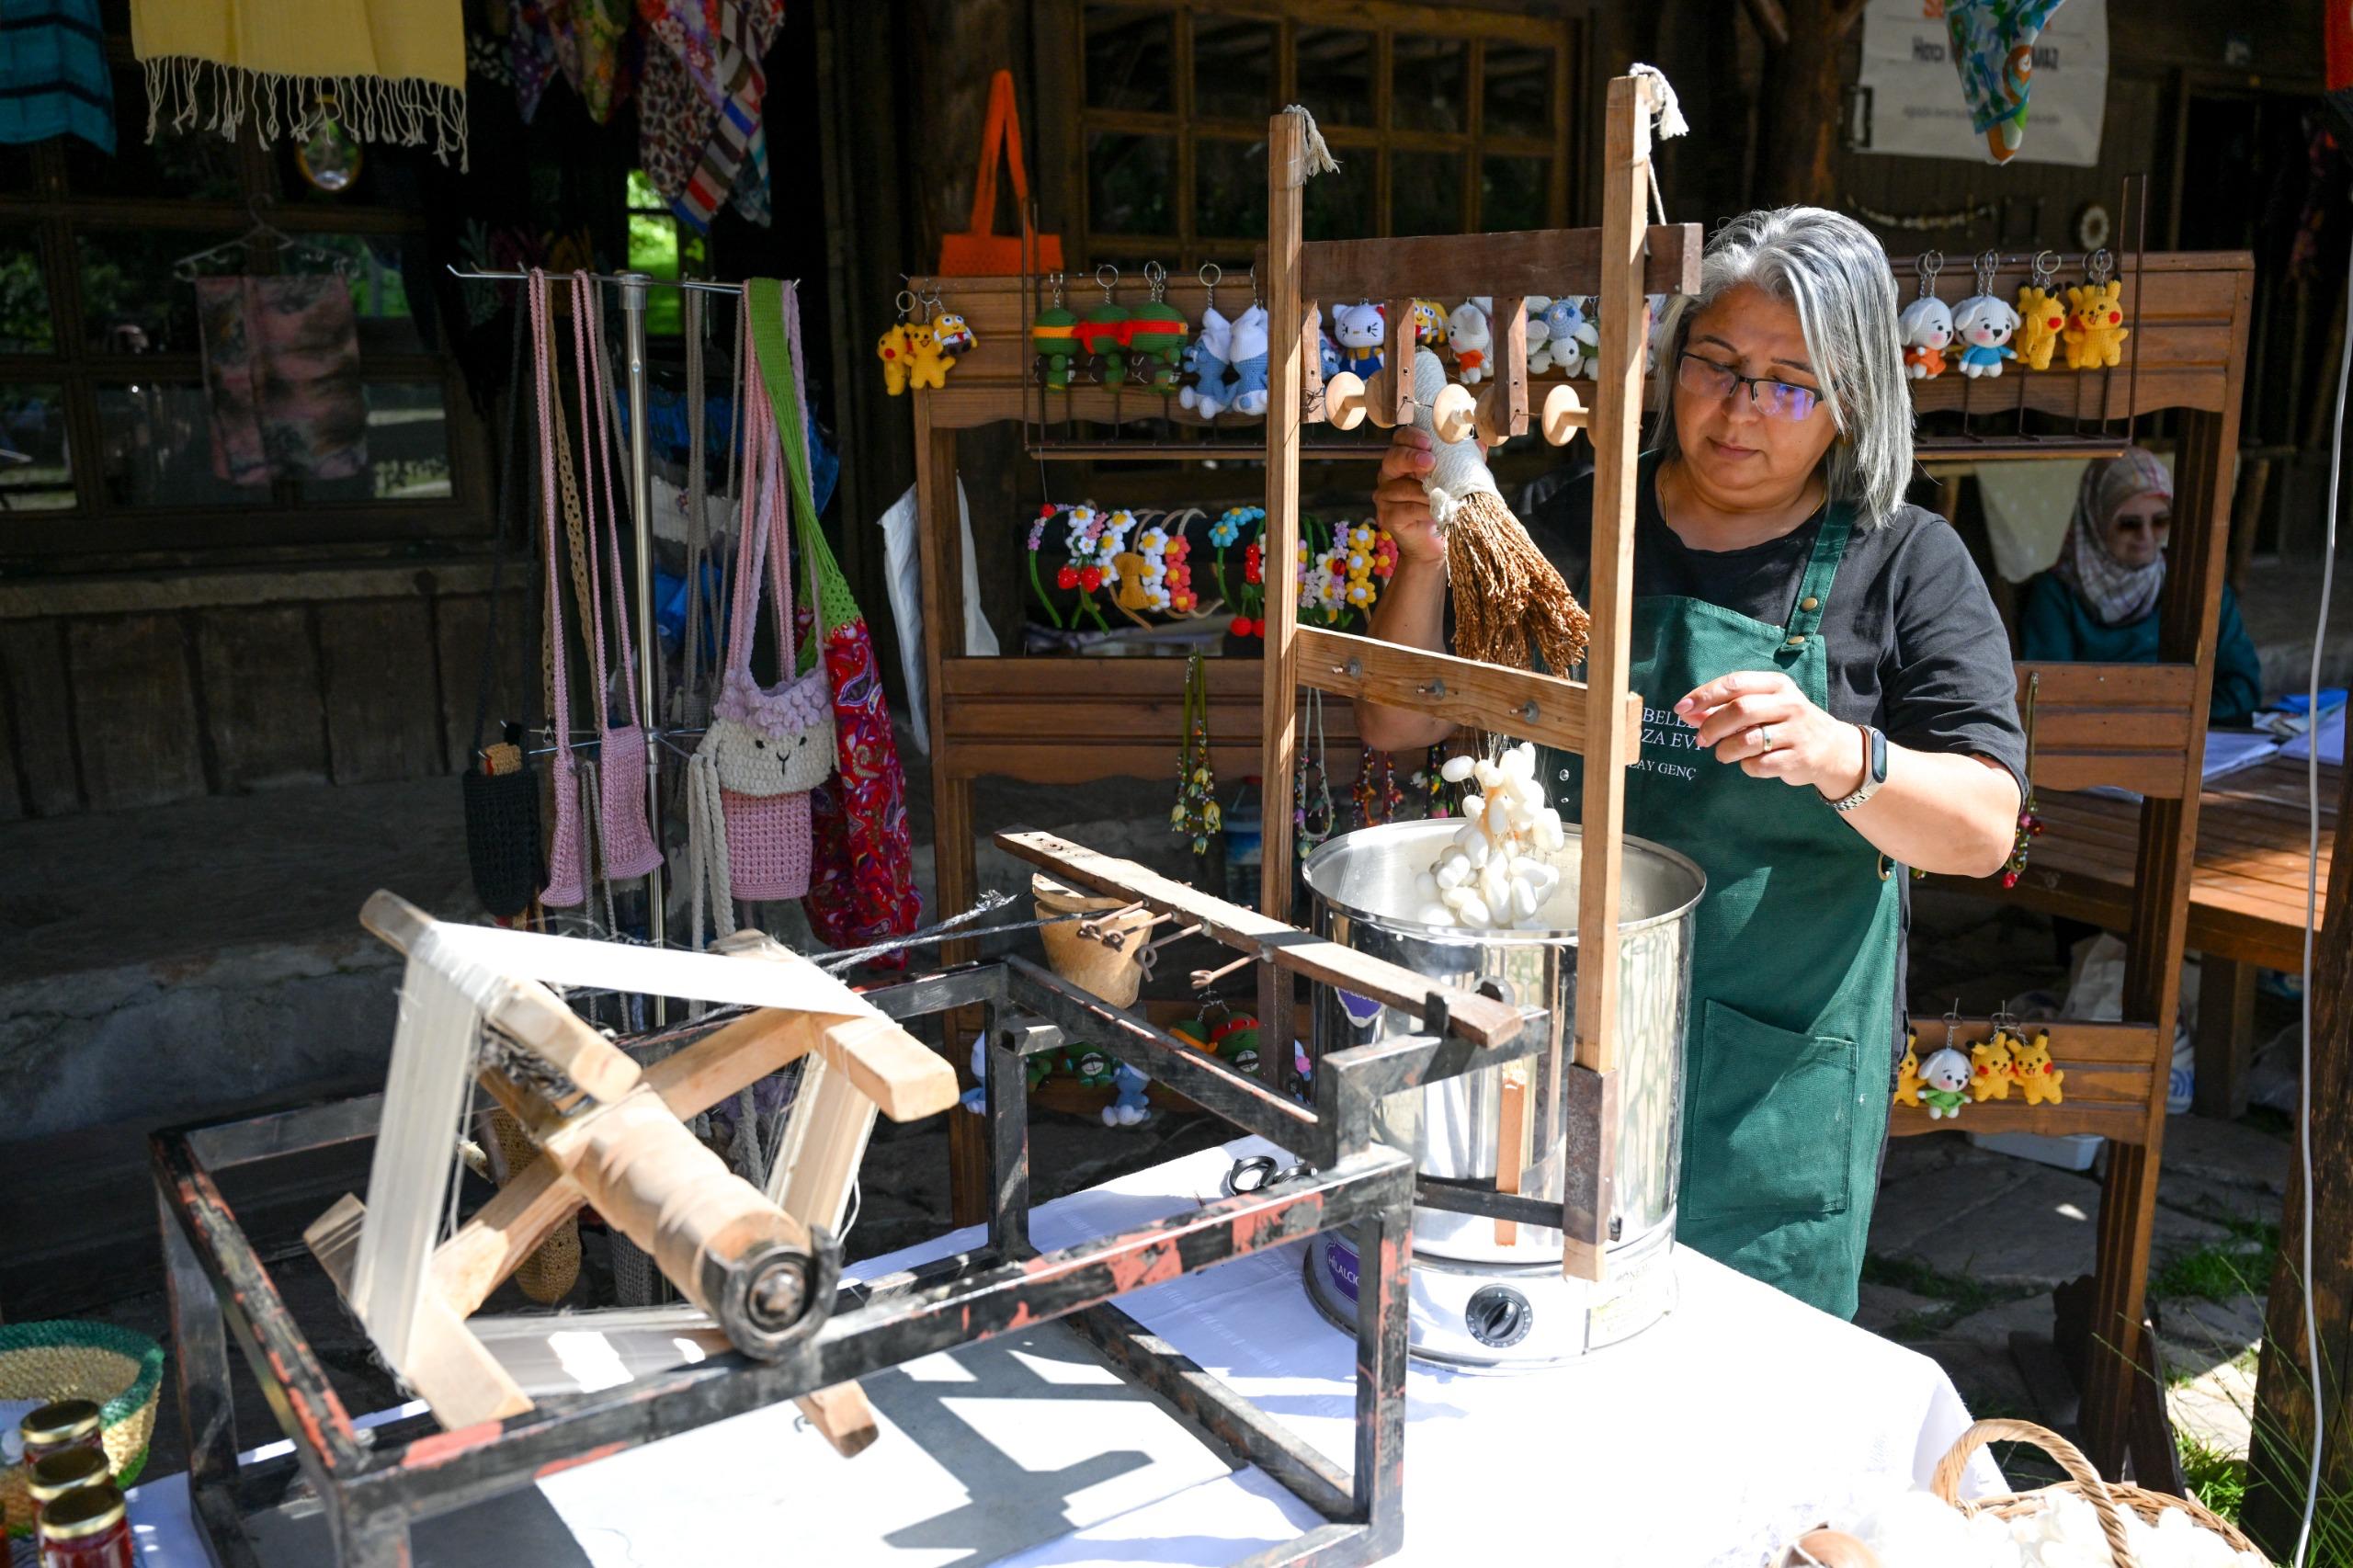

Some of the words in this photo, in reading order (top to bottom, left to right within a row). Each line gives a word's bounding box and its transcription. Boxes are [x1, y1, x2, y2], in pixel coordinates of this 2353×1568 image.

[1642, 707, 1699, 729] BEL
[1641, 728, 1665, 745] ZA
[1657, 762, 1697, 781] GENÇ
